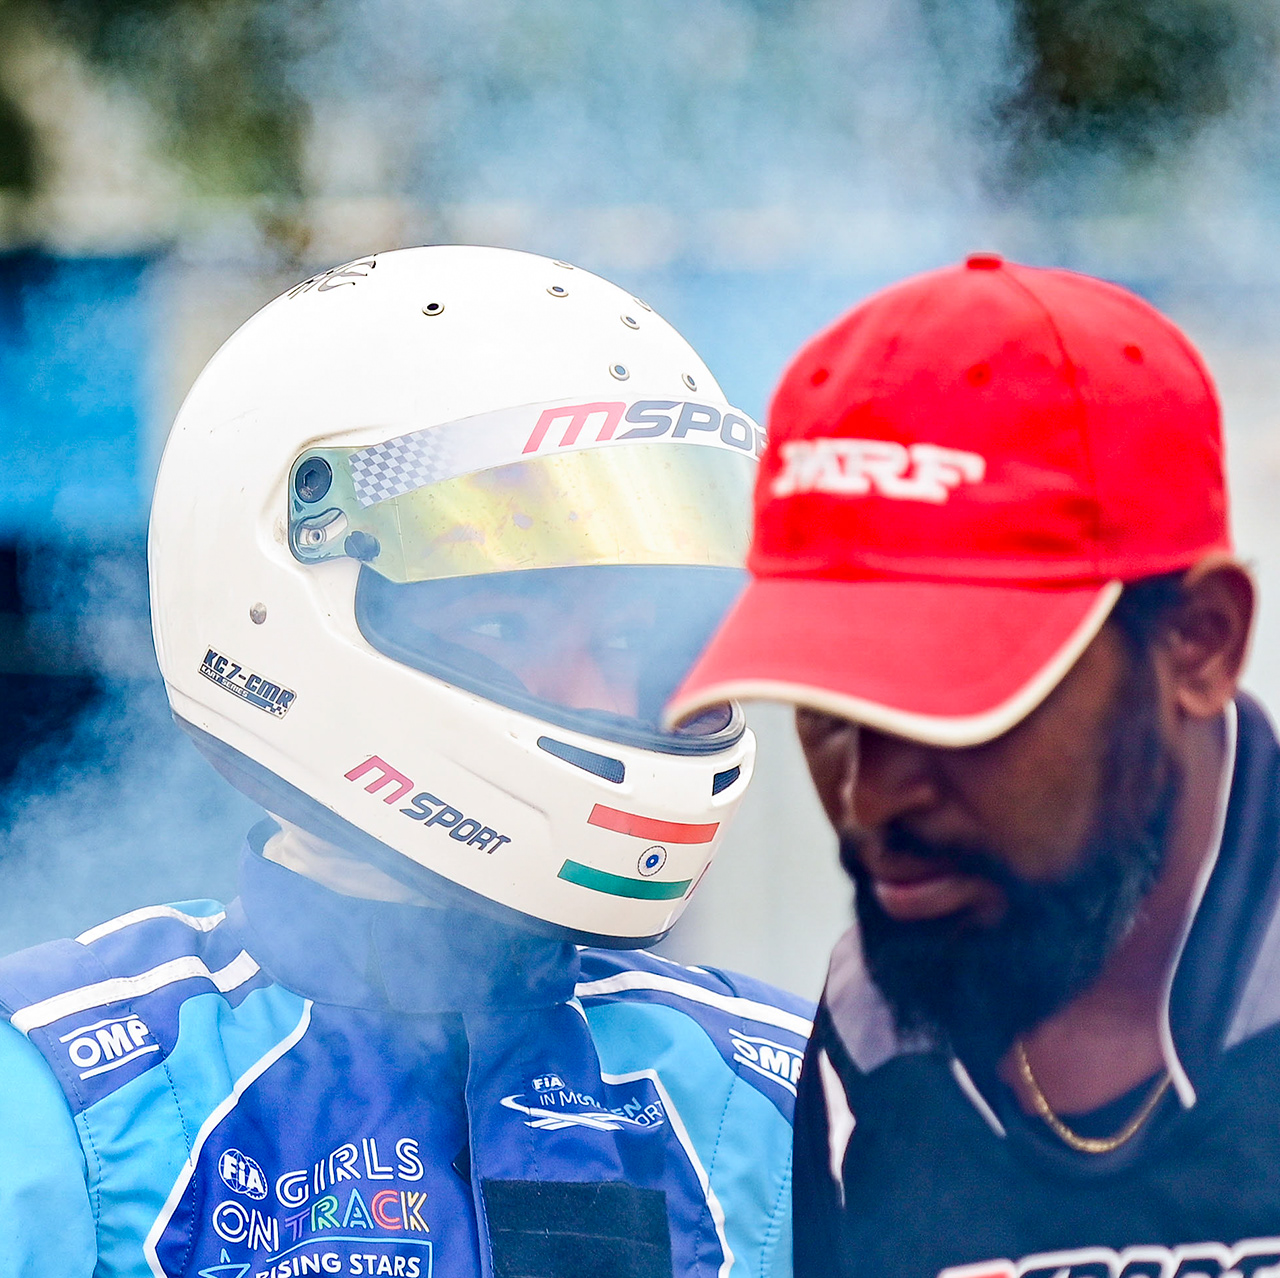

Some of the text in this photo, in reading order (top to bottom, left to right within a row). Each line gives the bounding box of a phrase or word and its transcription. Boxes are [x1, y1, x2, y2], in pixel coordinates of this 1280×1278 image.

[772, 437, 987, 505] MRF
[67, 1018, 150, 1068] OMP
[275, 1137, 424, 1208] GIRLS
[212, 1187, 430, 1252] ON TRACK
[349, 1254, 421, 1278] STARS
